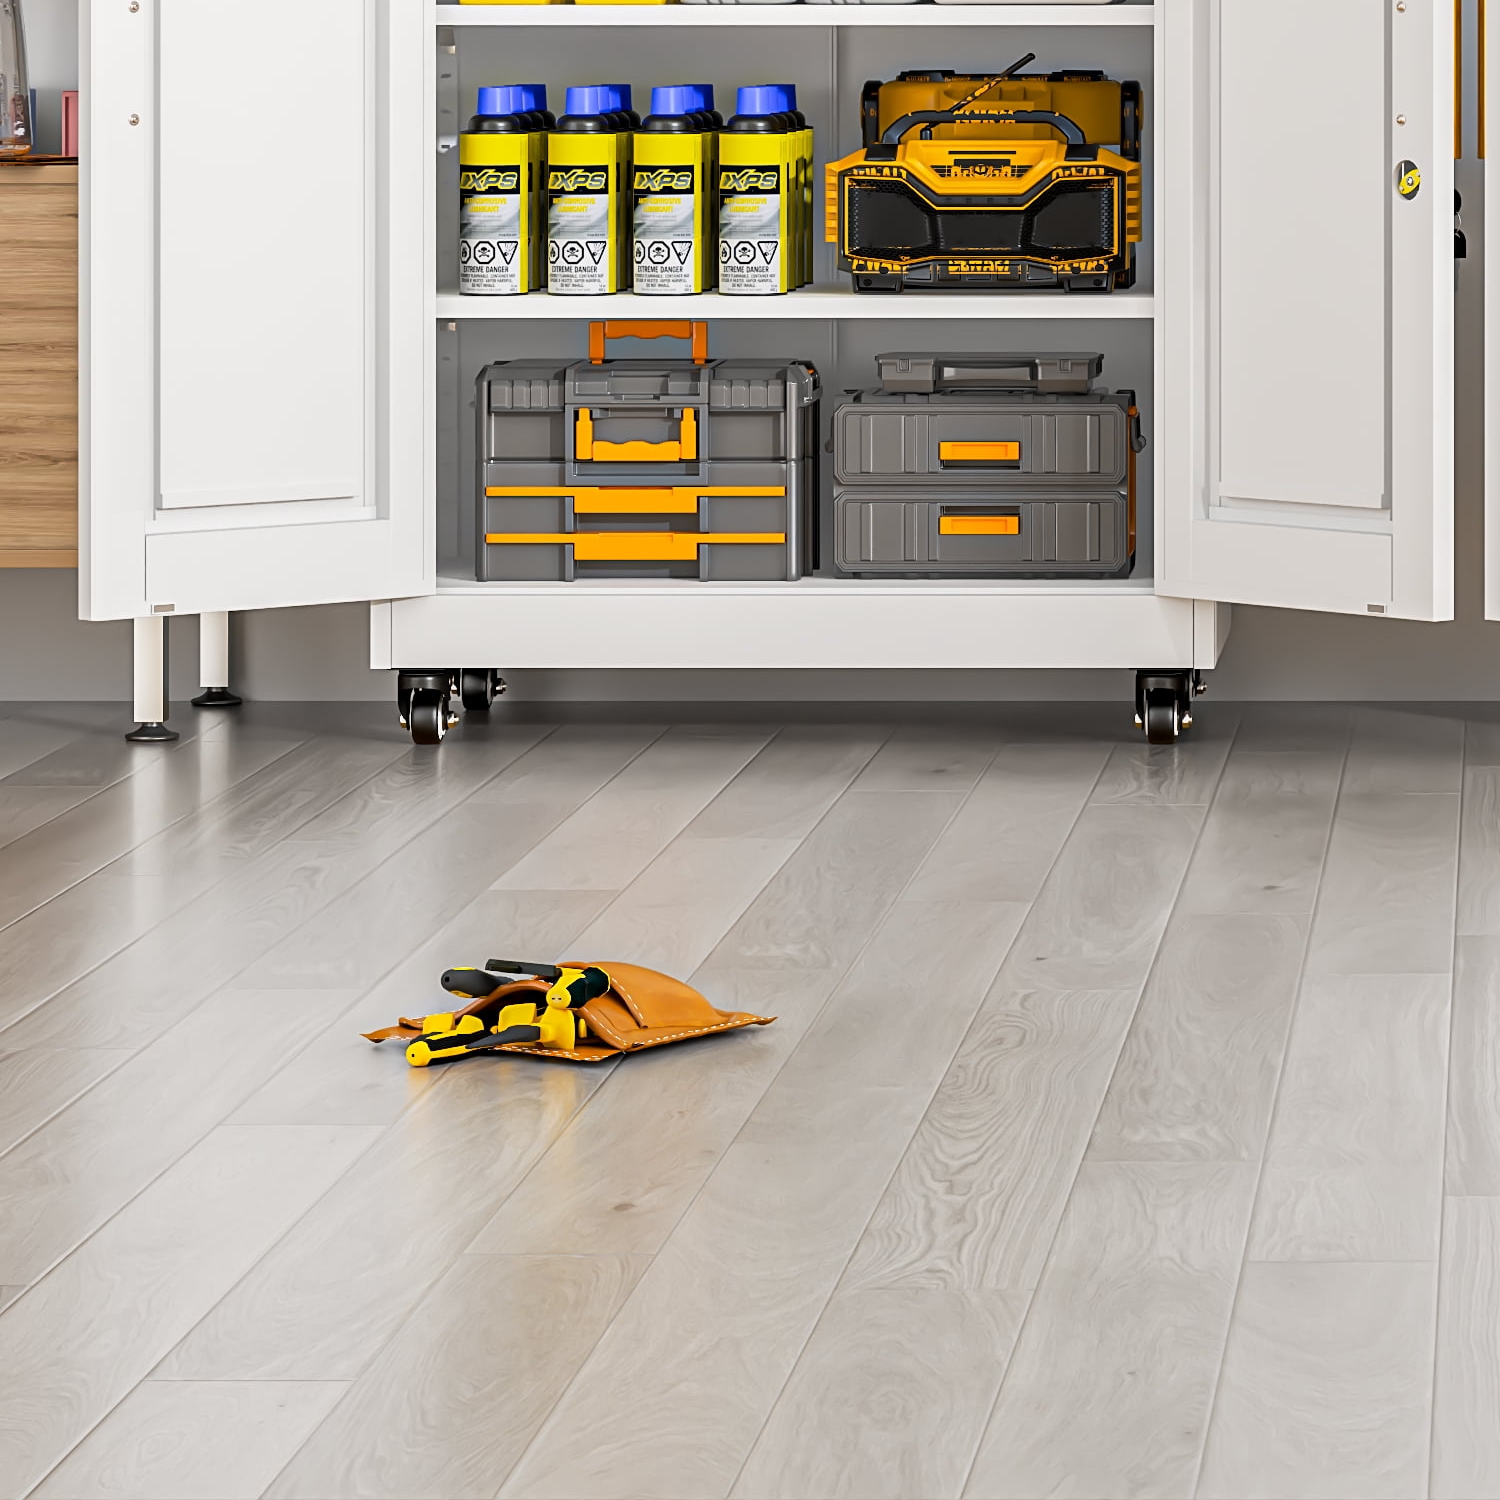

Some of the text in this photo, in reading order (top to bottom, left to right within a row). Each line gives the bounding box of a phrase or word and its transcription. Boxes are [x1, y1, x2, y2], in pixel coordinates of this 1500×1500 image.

[464, 169, 518, 191] XPS
[552, 169, 606, 191] XPS
[637, 169, 692, 191] XPS
[722, 169, 777, 191] XPS
[485, 265, 509, 273] DANGER
[574, 265, 598, 273] DANGER
[660, 265, 684, 273] DANGER
[746, 265, 769, 273] DANGER
